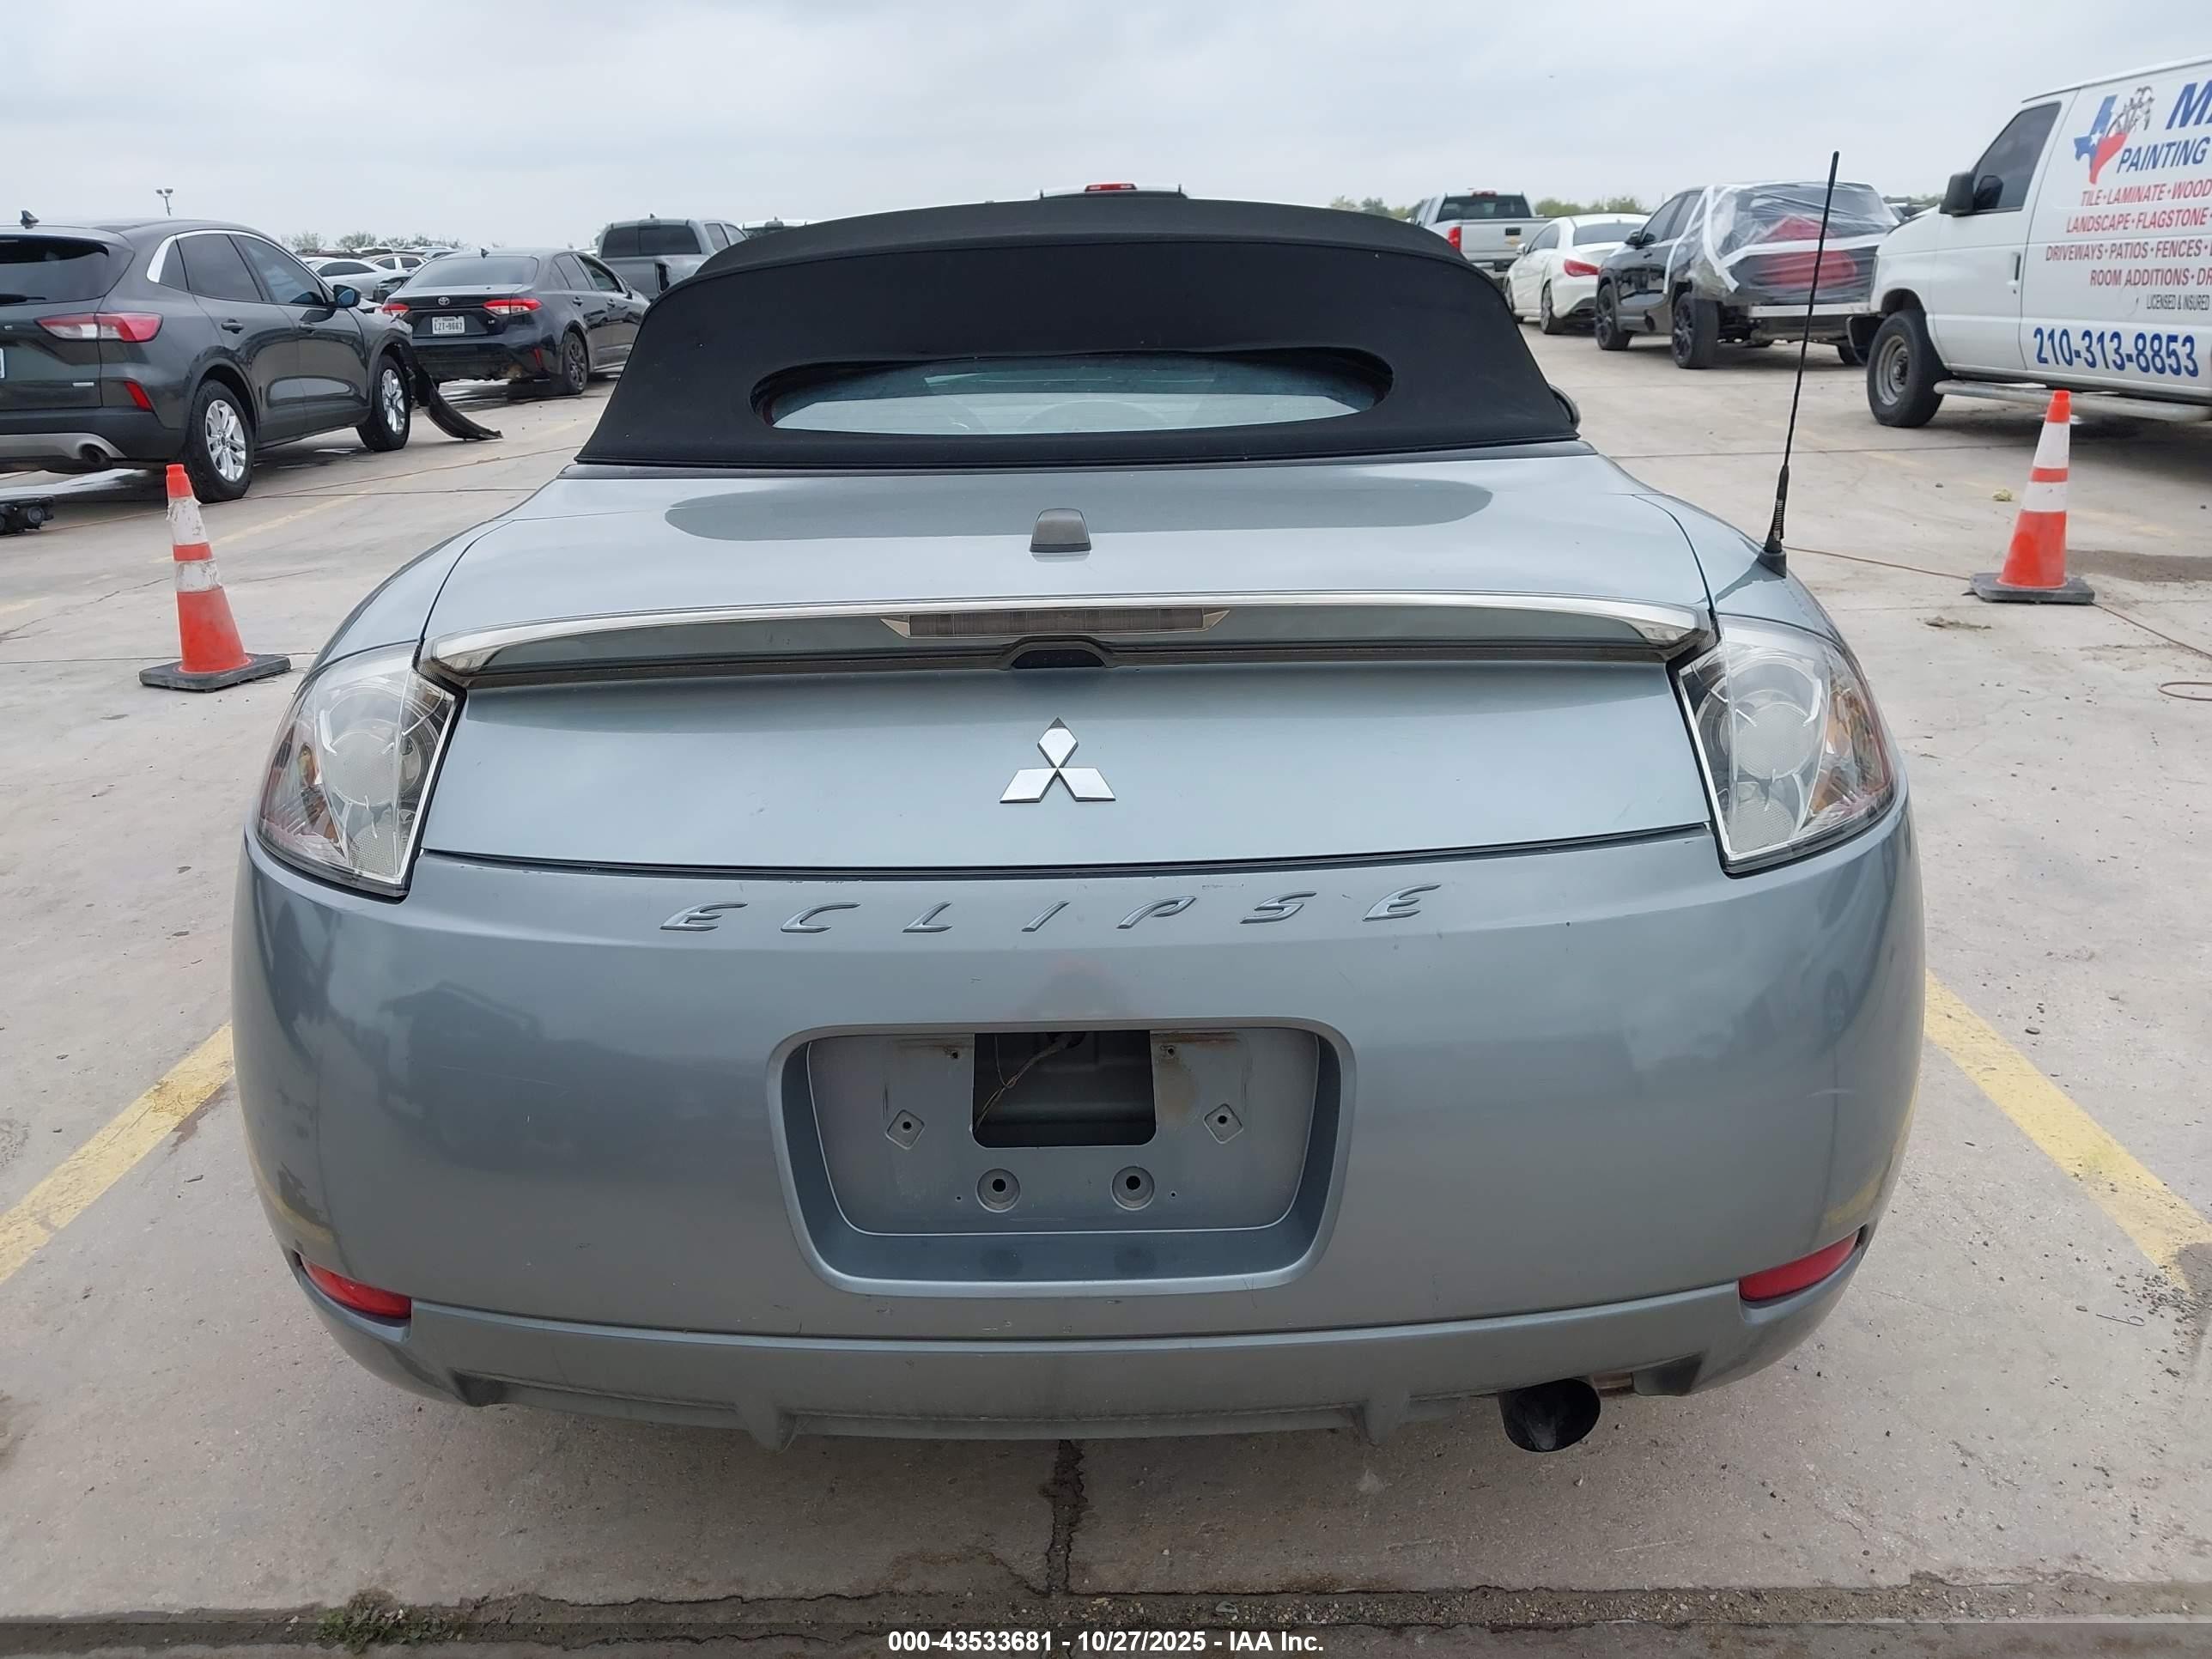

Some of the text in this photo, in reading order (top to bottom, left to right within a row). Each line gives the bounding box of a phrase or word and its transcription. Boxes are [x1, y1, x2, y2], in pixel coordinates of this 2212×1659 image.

[2116, 137, 2211, 174] PAINTING
[2081, 189, 2103, 207] TILE
[2106, 183, 2167, 205] LAMINATE
[2066, 207, 2209, 234] LANDSCAPE FLAGSTONE
[2045, 244, 2104, 261] DRIVEWAYS
[2109, 241, 2149, 259] PATIOS
[2155, 239, 2203, 258] FENCES
[2090, 270, 2122, 286] ROOM
[2124, 267, 2190, 286] ADDITIONS
[2033, 327, 2199, 377] 210-313-8853
[659, 883, 1442, 933] ECLIPSE
